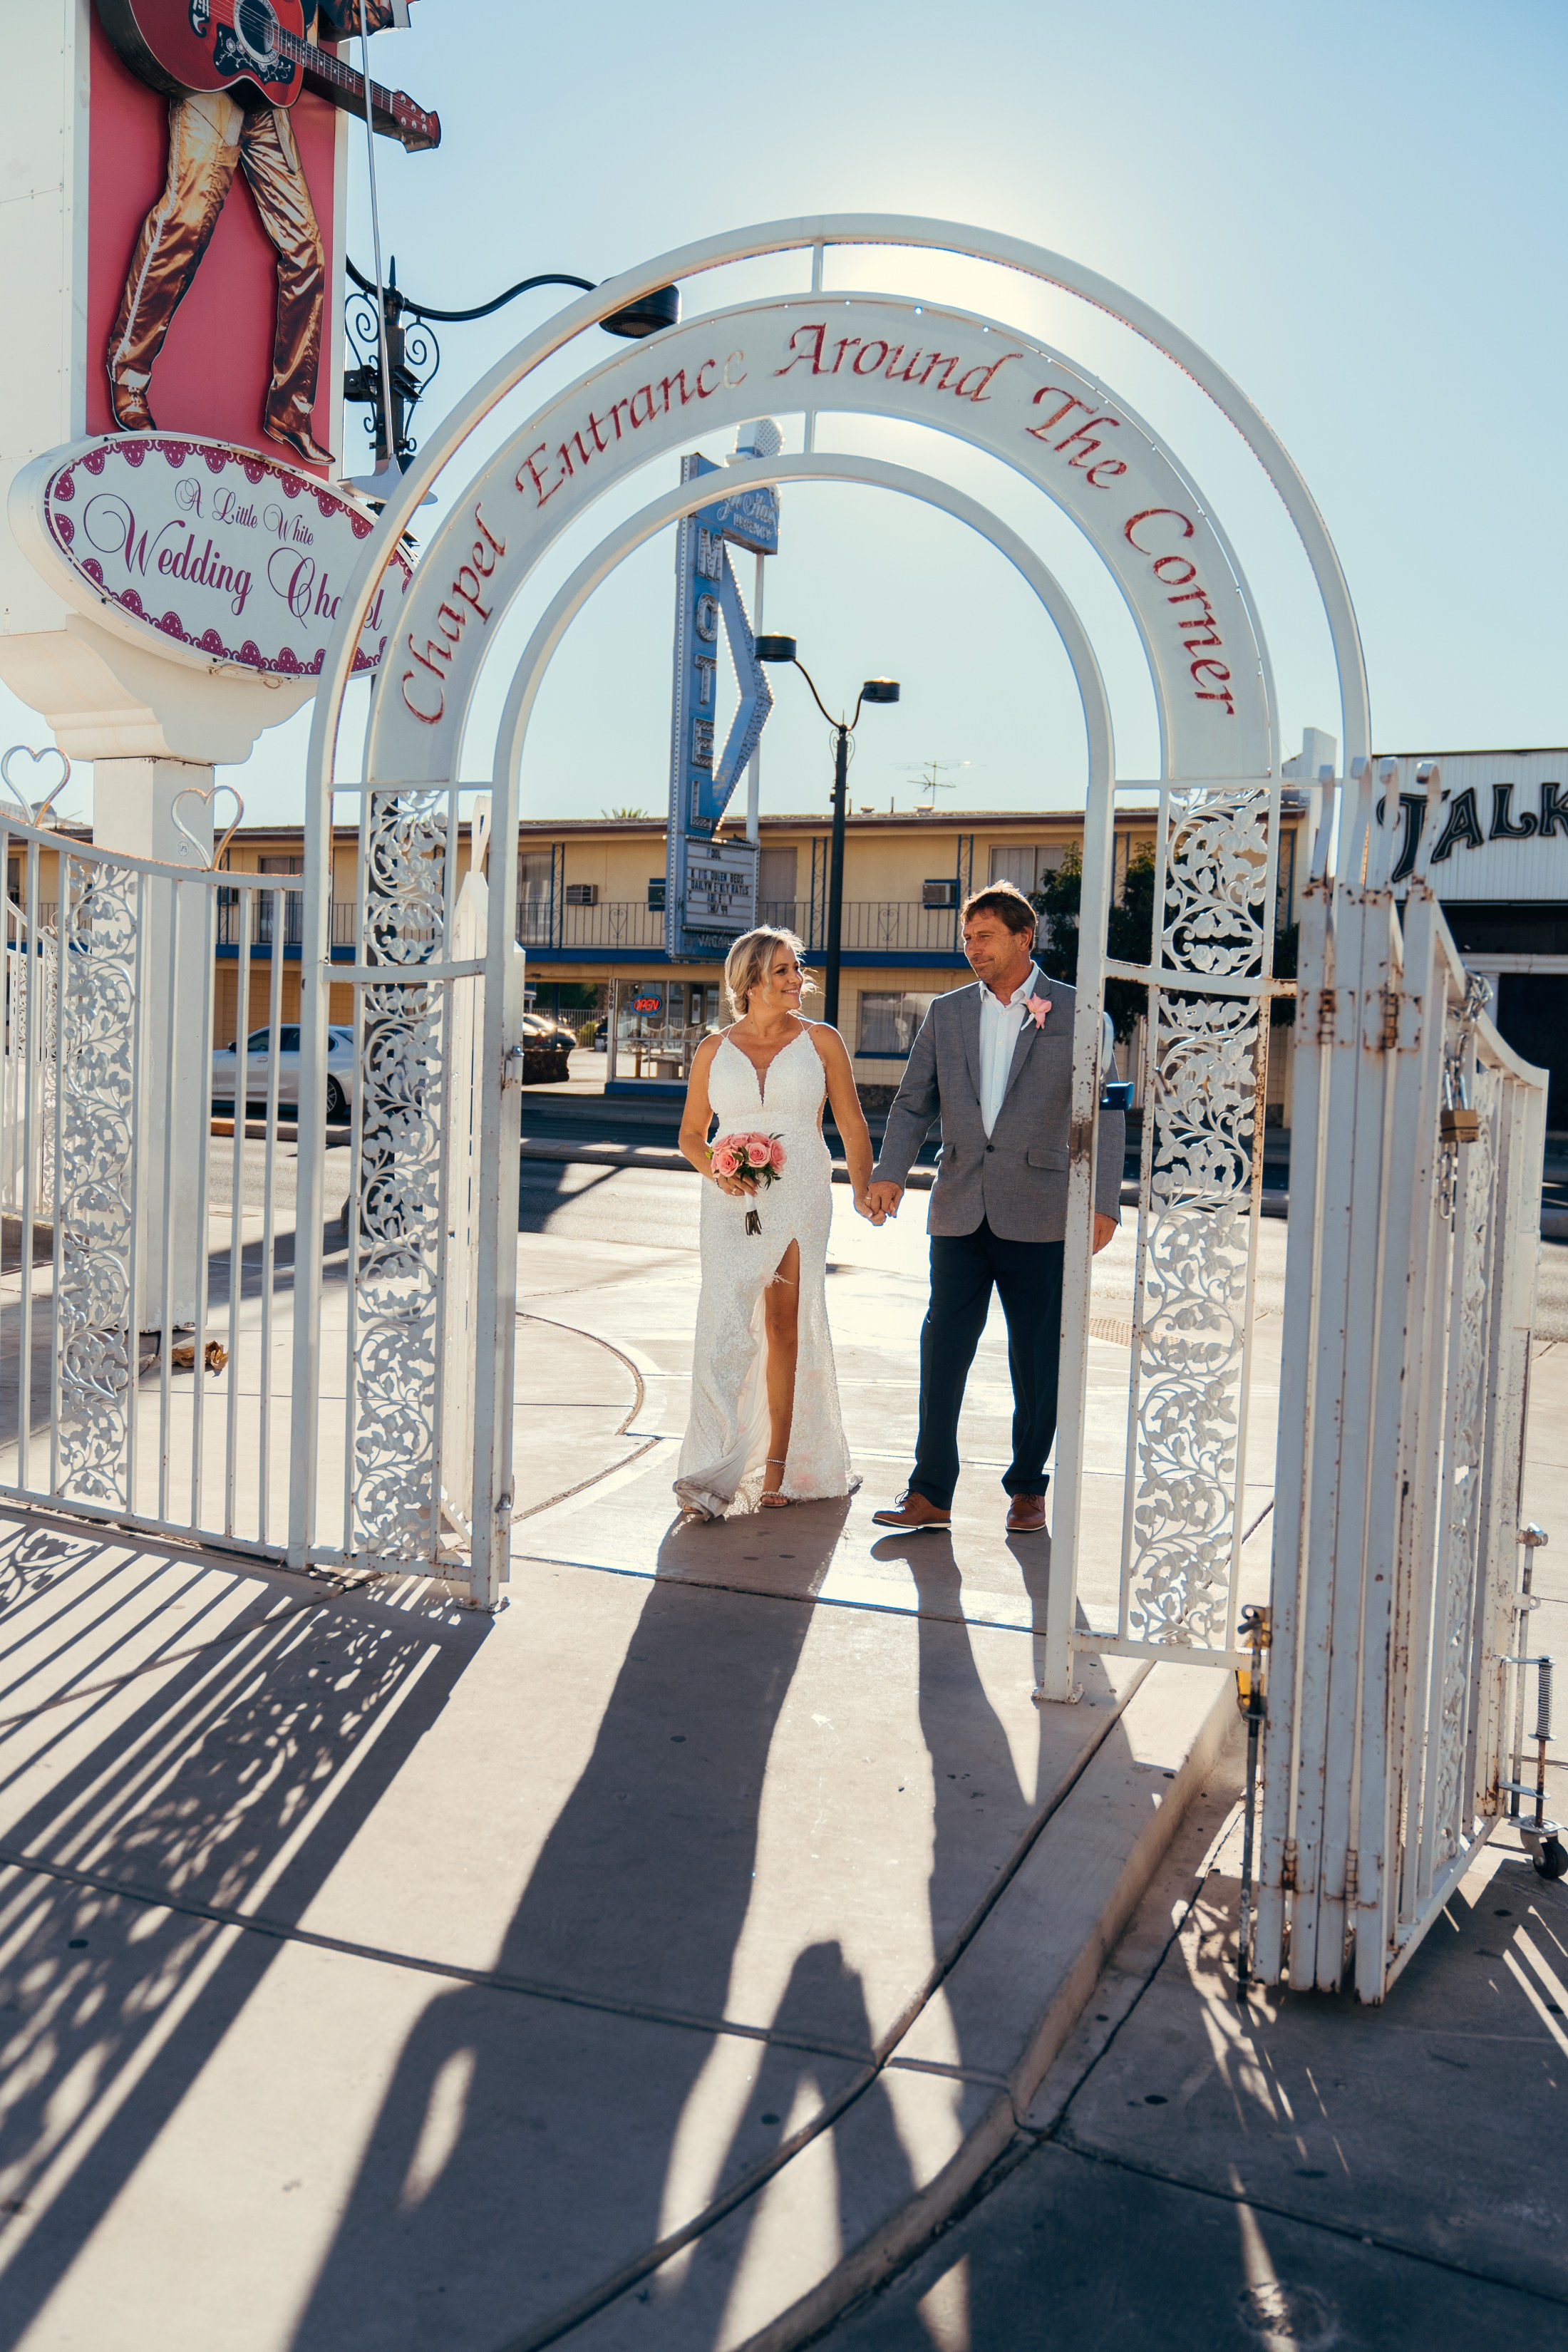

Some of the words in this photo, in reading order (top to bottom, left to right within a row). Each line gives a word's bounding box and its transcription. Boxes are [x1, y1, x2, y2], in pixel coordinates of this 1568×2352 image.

[175, 477, 204, 519] A
[212, 487, 258, 530] Little
[263, 503, 314, 547] White
[401, 502, 506, 726] Chapel
[514, 350, 748, 509] Entrance
[773, 322, 1024, 402] Around
[1025, 386, 1128, 490] The
[1123, 507, 1235, 716] Corner
[83, 493, 253, 616] Wedding
[267, 547, 385, 631] Chael
[689, 527, 724, 830] MOTEL
[707, 847, 721, 860] POOL
[691, 868, 707, 880] KIG
[711, 870, 727, 882] QUEEN
[730, 873, 743, 884] BEDS
[707, 881, 729, 893] WEKLY
[731, 884, 749, 896] RATES
[633, 999, 660, 1011] OPEN
